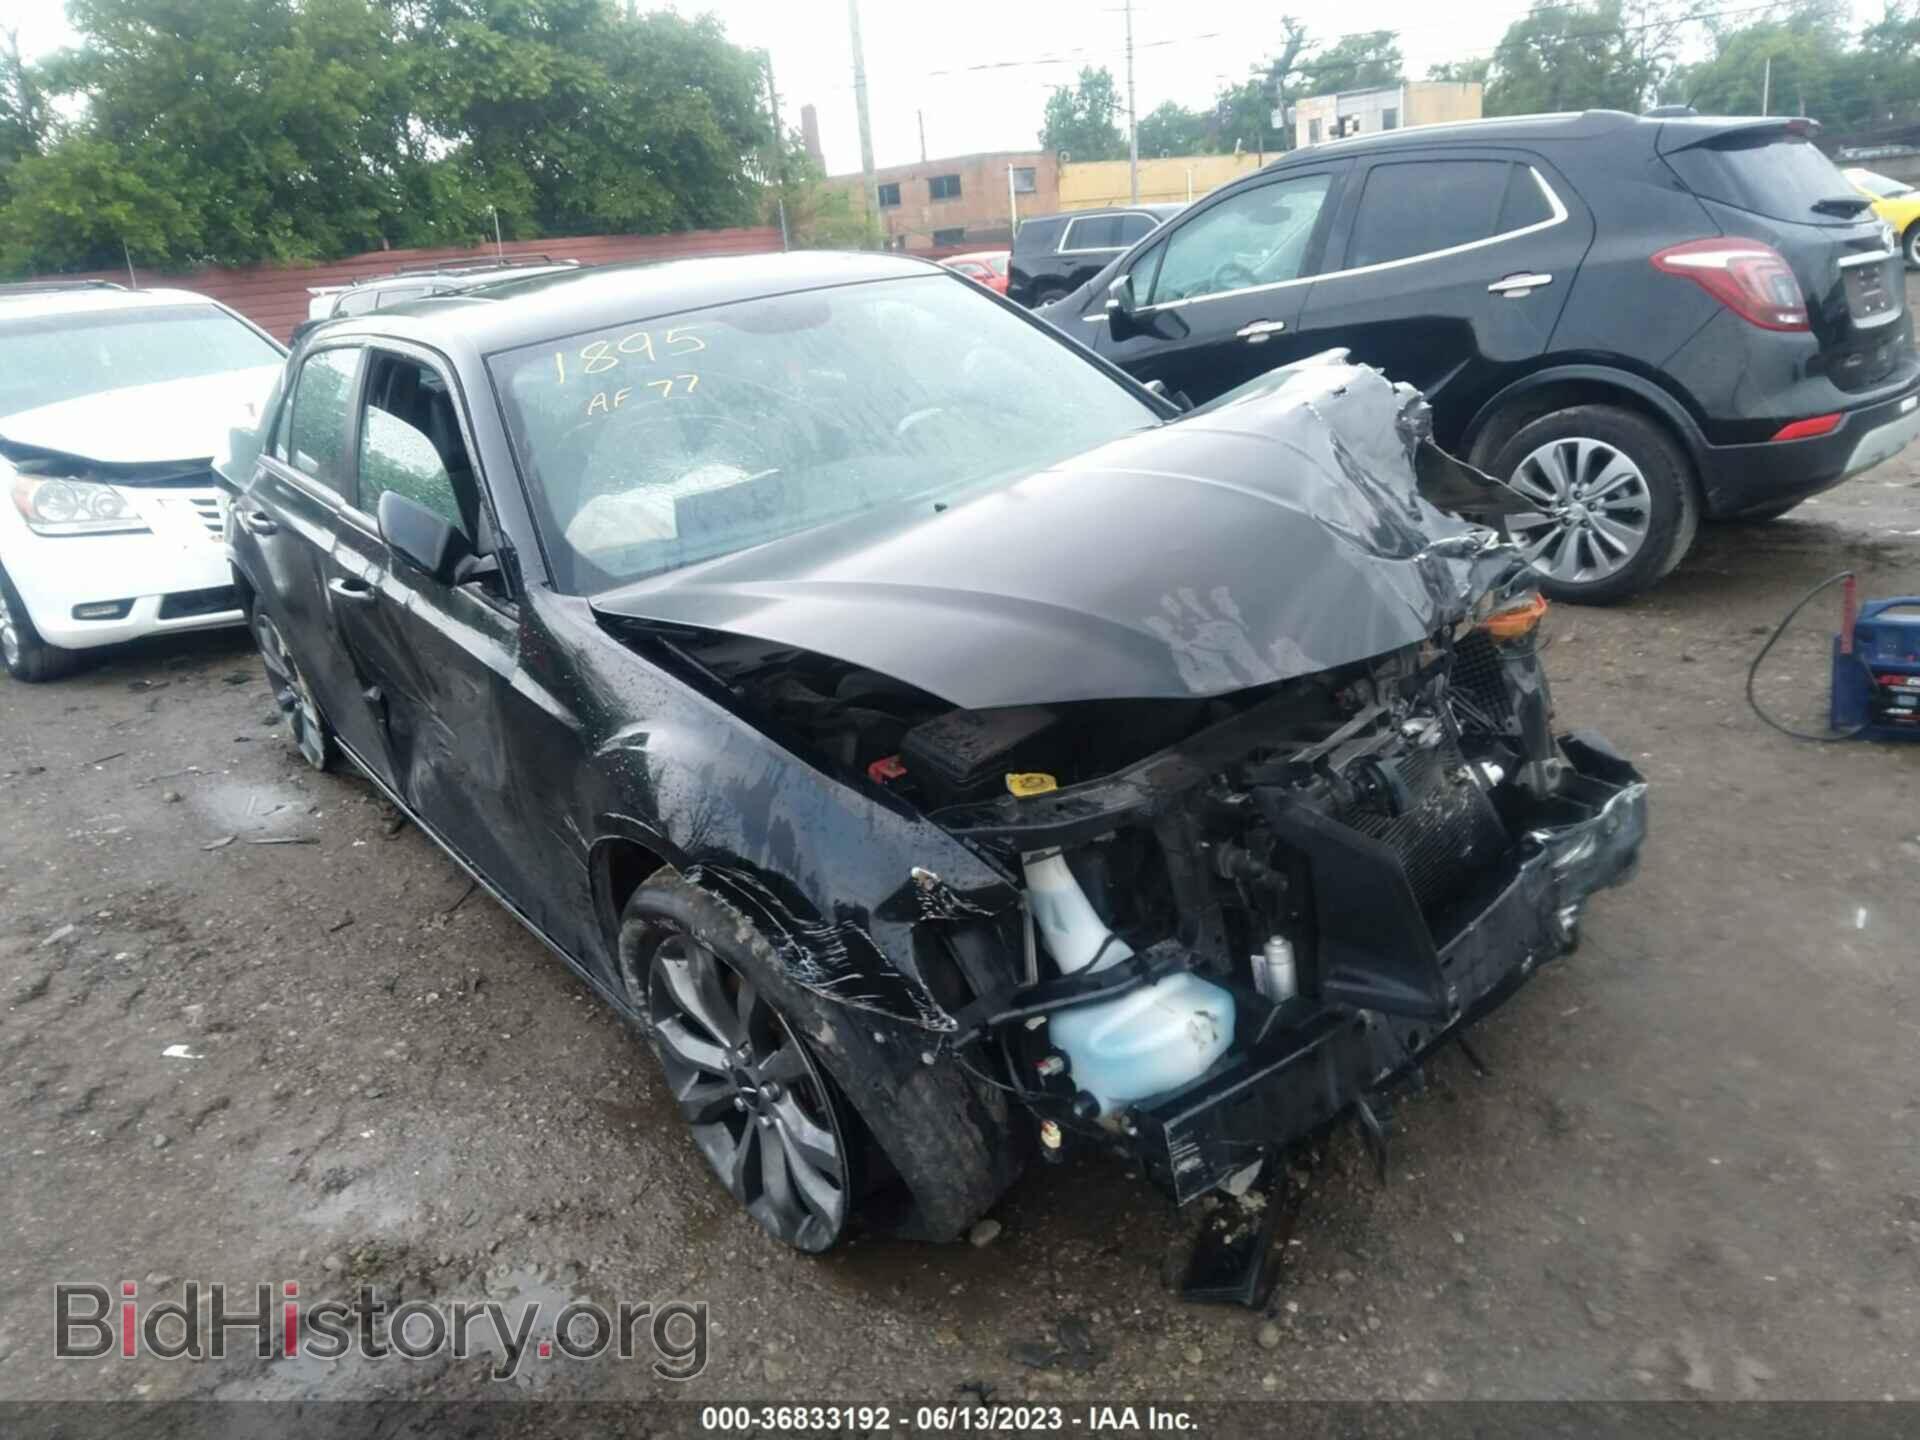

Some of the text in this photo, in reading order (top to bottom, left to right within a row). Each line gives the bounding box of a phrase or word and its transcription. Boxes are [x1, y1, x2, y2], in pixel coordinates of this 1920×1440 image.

[555, 326, 706, 385] 1895
[586, 373, 699, 416] AF 77
